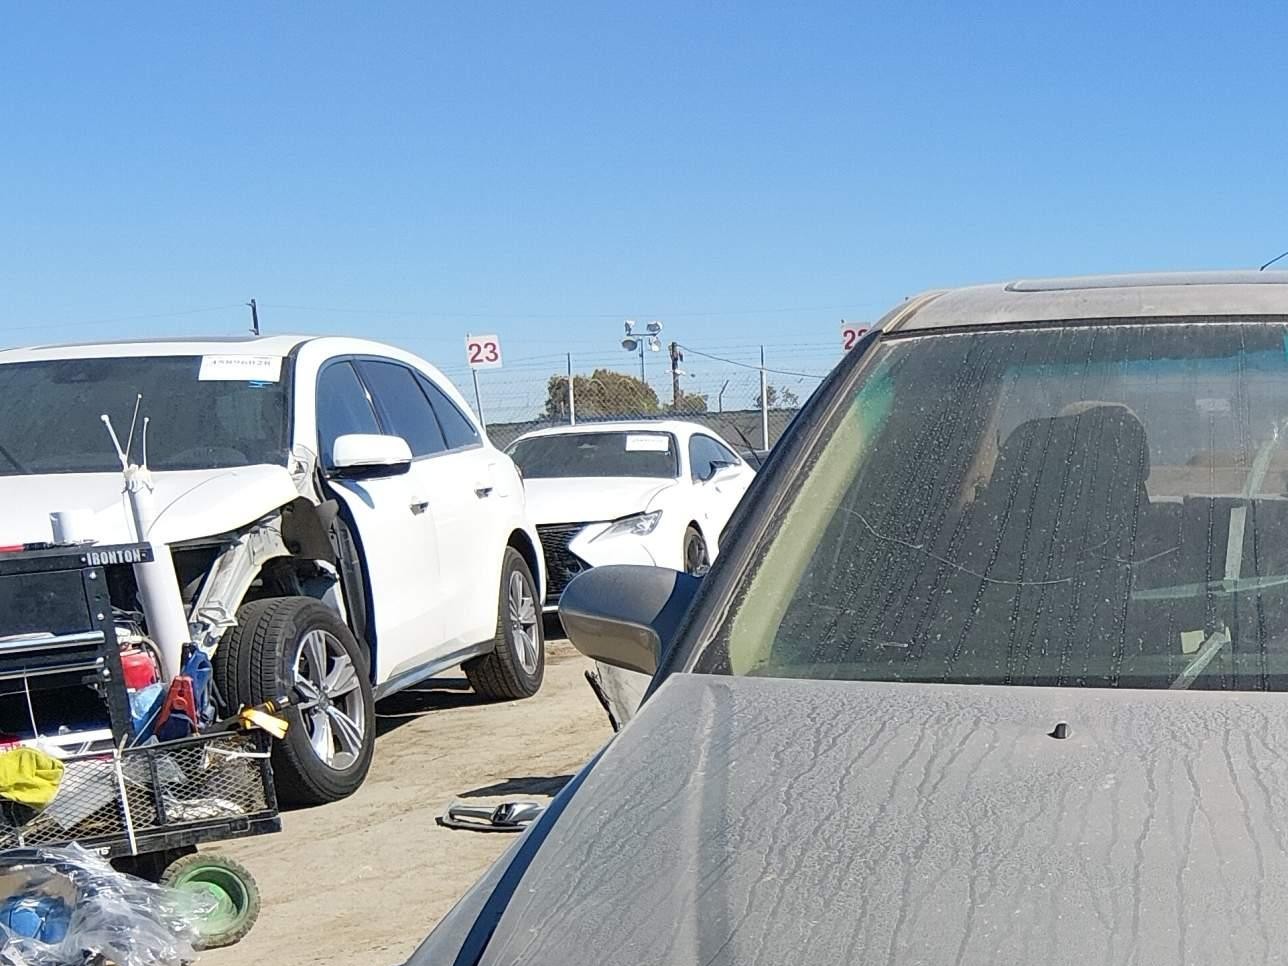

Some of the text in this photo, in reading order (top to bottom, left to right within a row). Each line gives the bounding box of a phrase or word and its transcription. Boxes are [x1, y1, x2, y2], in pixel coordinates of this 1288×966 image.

[843, 329, 868, 350] 2
[469, 342, 499, 363] 23
[86, 549, 141, 566] IRONTON
